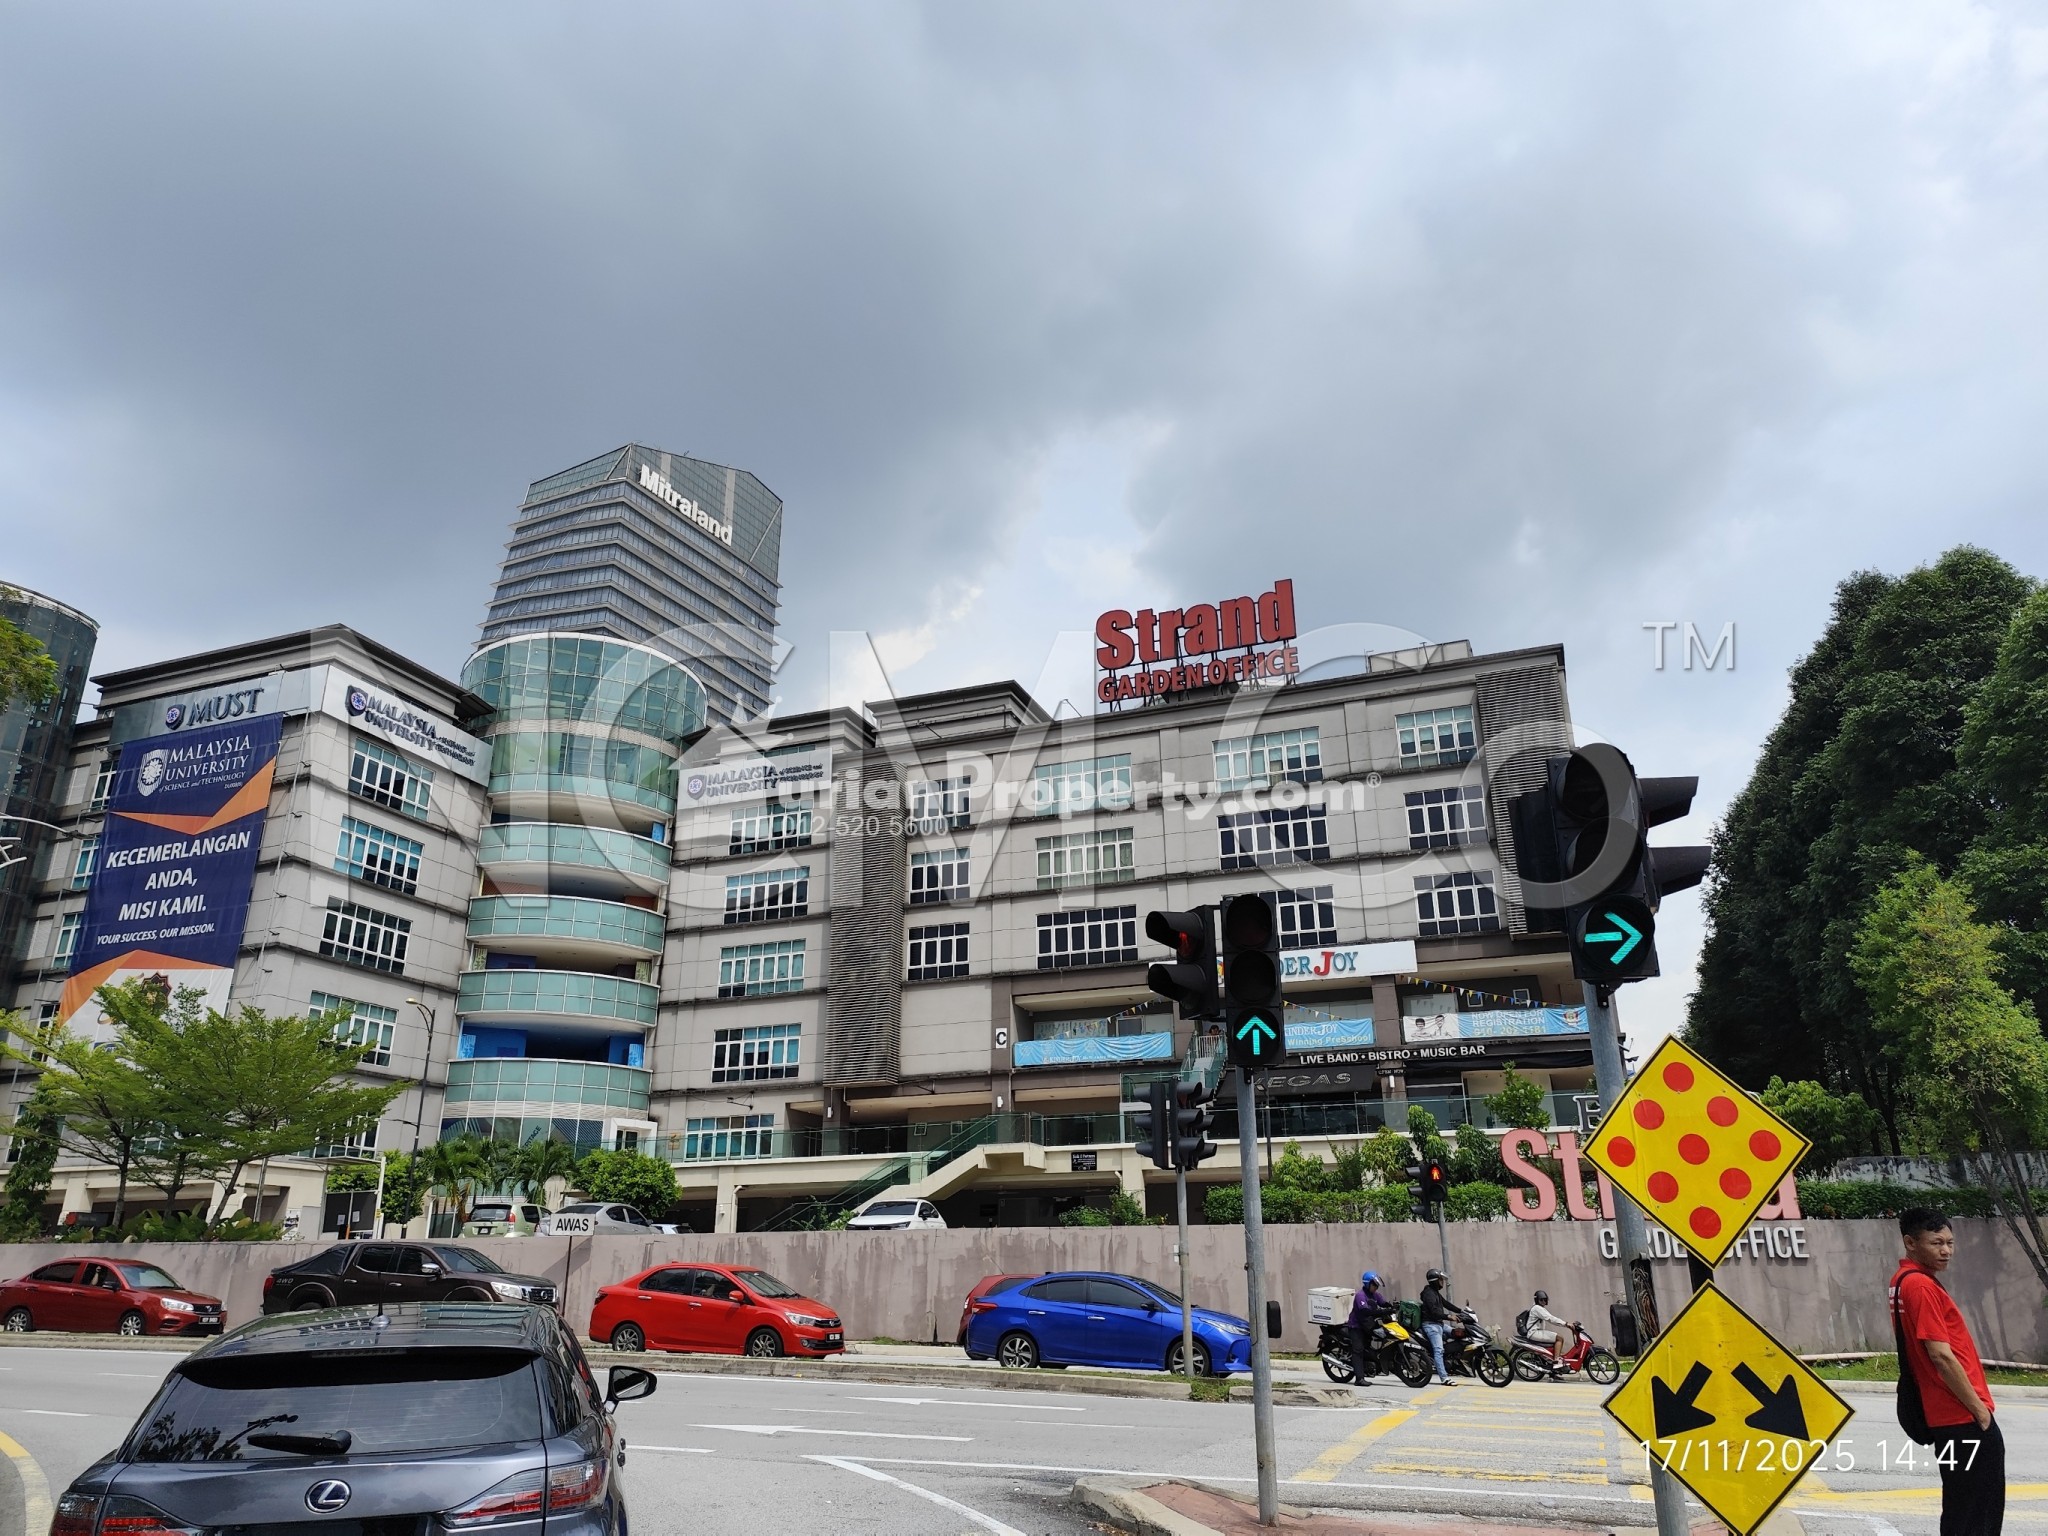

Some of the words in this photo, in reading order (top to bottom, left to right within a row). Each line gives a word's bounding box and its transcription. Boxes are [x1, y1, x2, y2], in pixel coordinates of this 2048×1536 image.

[640, 464, 733, 546] Mitraland
[1096, 578, 1297, 669] Strand
[1098, 664, 1204, 703] GARDEN
[1207, 646, 1300, 685] OFFICE
[186, 687, 265, 727] MUST
[367, 696, 436, 739] MALAYSIA
[364, 710, 436, 751] UNIVERSITY
[169, 735, 251, 764] MALAYSIA
[165, 755, 250, 782] UNIVERSITY
[707, 765, 778, 786] MALAYSIA
[164, 781, 191, 792] SCIENCE
[201, 771, 247, 786] TECHNOLOGY
[706, 778, 779, 798] UNIVERSITY
[106, 830, 251, 868] KECEMERLANGAN
[145, 867, 198, 891] ANDA,
[118, 900, 157, 921] MISI
[158, 894, 207, 917] KAMI.
[97, 934, 121, 946] YOUR
[120, 930, 158, 944] SUCCESS,
[159, 927, 178, 938] OUR
[179, 922, 215, 937] MISSION.
[1314, 951, 1359, 976] JOY
[1471, 1011, 1494, 1020] NOW
[1471, 1016, 1545, 1028] REGISTRATION
[997, 1032, 1006, 1045] C
[1288, 1038, 1323, 1047] Winning
[1325, 1033, 1371, 1043] PreSchool
[1317, 1024, 1338, 1036] JOY
[1300, 1055, 1324, 1065] LIVE
[1327, 1053, 1358, 1063] BAND
[1368, 1050, 1411, 1061] BISTRO
[1420, 1047, 1456, 1058] MUSIC
[1461, 1045, 1486, 1055] BAR
[556, 1218, 589, 1232] AWAS
[1724, 1227, 1811, 1259] FFICE
